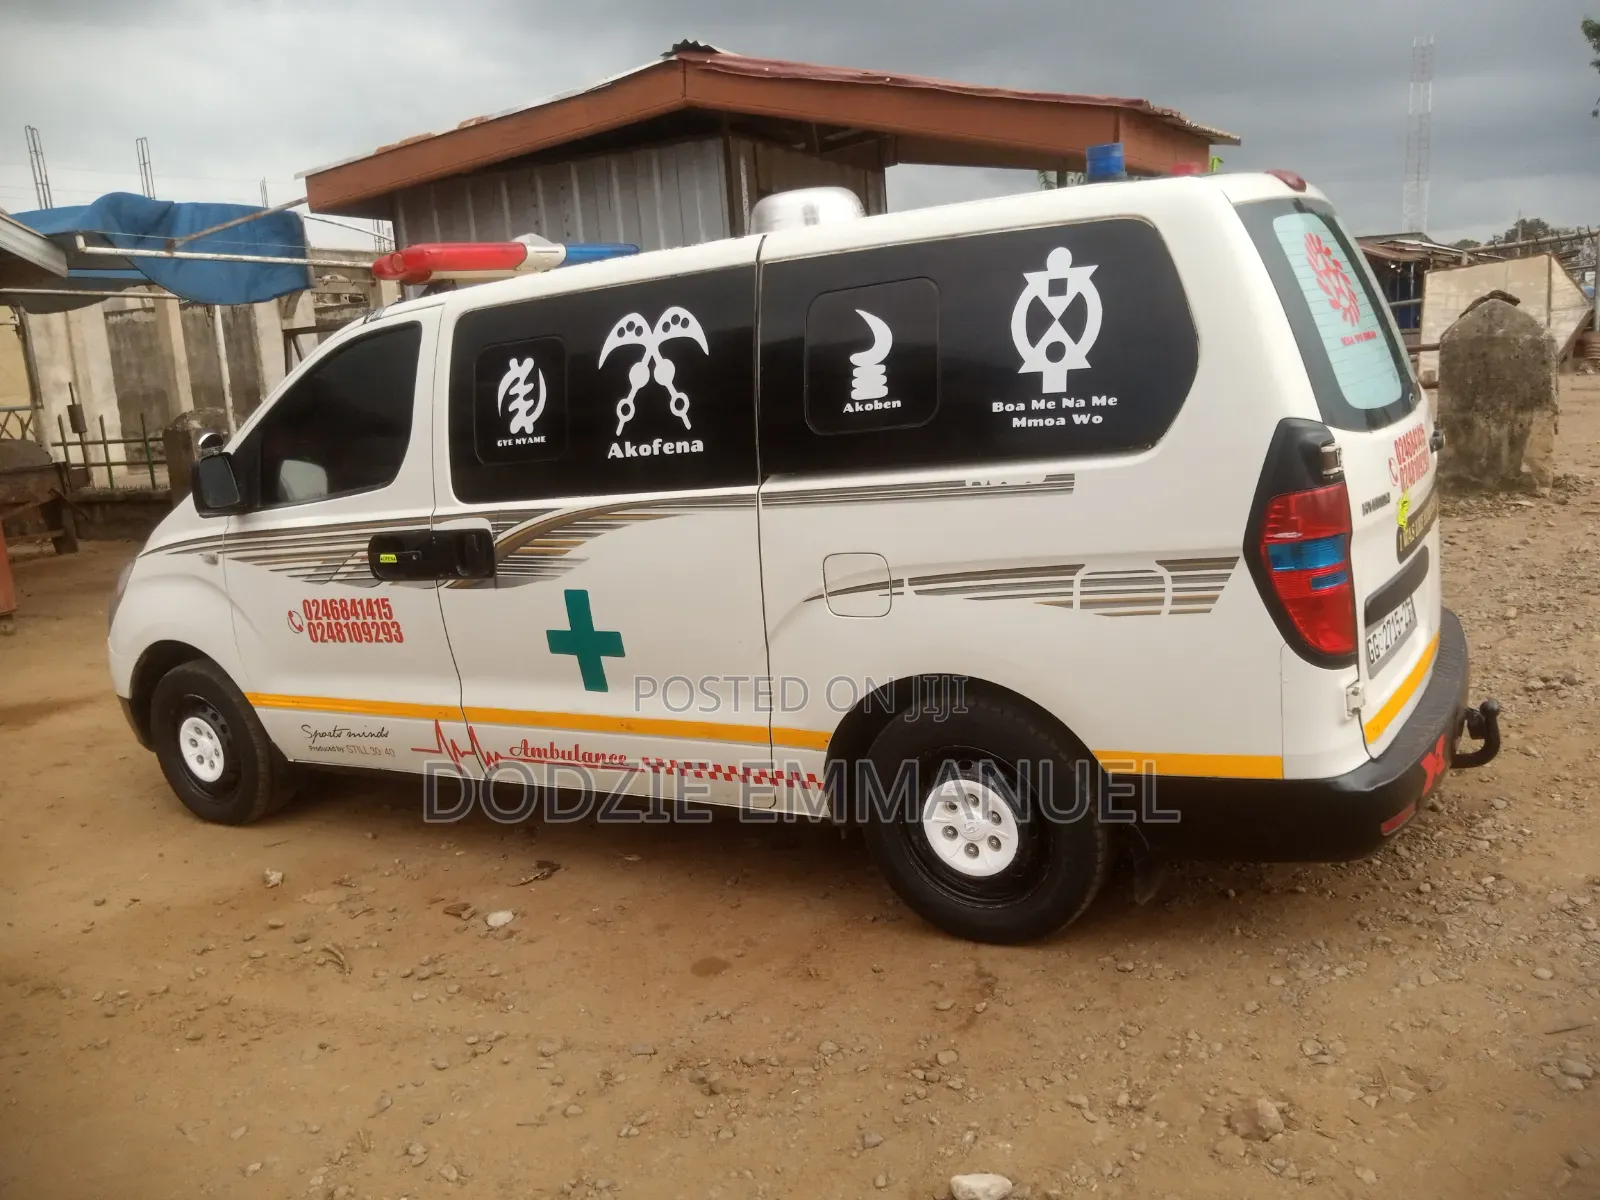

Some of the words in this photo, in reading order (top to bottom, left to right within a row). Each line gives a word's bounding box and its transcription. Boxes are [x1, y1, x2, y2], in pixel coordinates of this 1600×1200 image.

[843, 400, 902, 413] Akoben
[992, 402, 1025, 413] Boa
[1031, 400, 1056, 410] Me
[1062, 398, 1085, 408] Na
[1091, 396, 1118, 407] Me
[1012, 417, 1066, 428] Mmoa
[1072, 414, 1103, 424] Wo
[497, 439, 514, 447] GYE
[515, 436, 546, 445] NYAME
[607, 438, 704, 459] Akofena
[302, 598, 393, 621] 0246841415
[307, 621, 404, 643] 0248109293
[301, 724, 343, 744] Sports
[346, 725, 390, 738] minds
[508, 738, 630, 766] Ambulance
